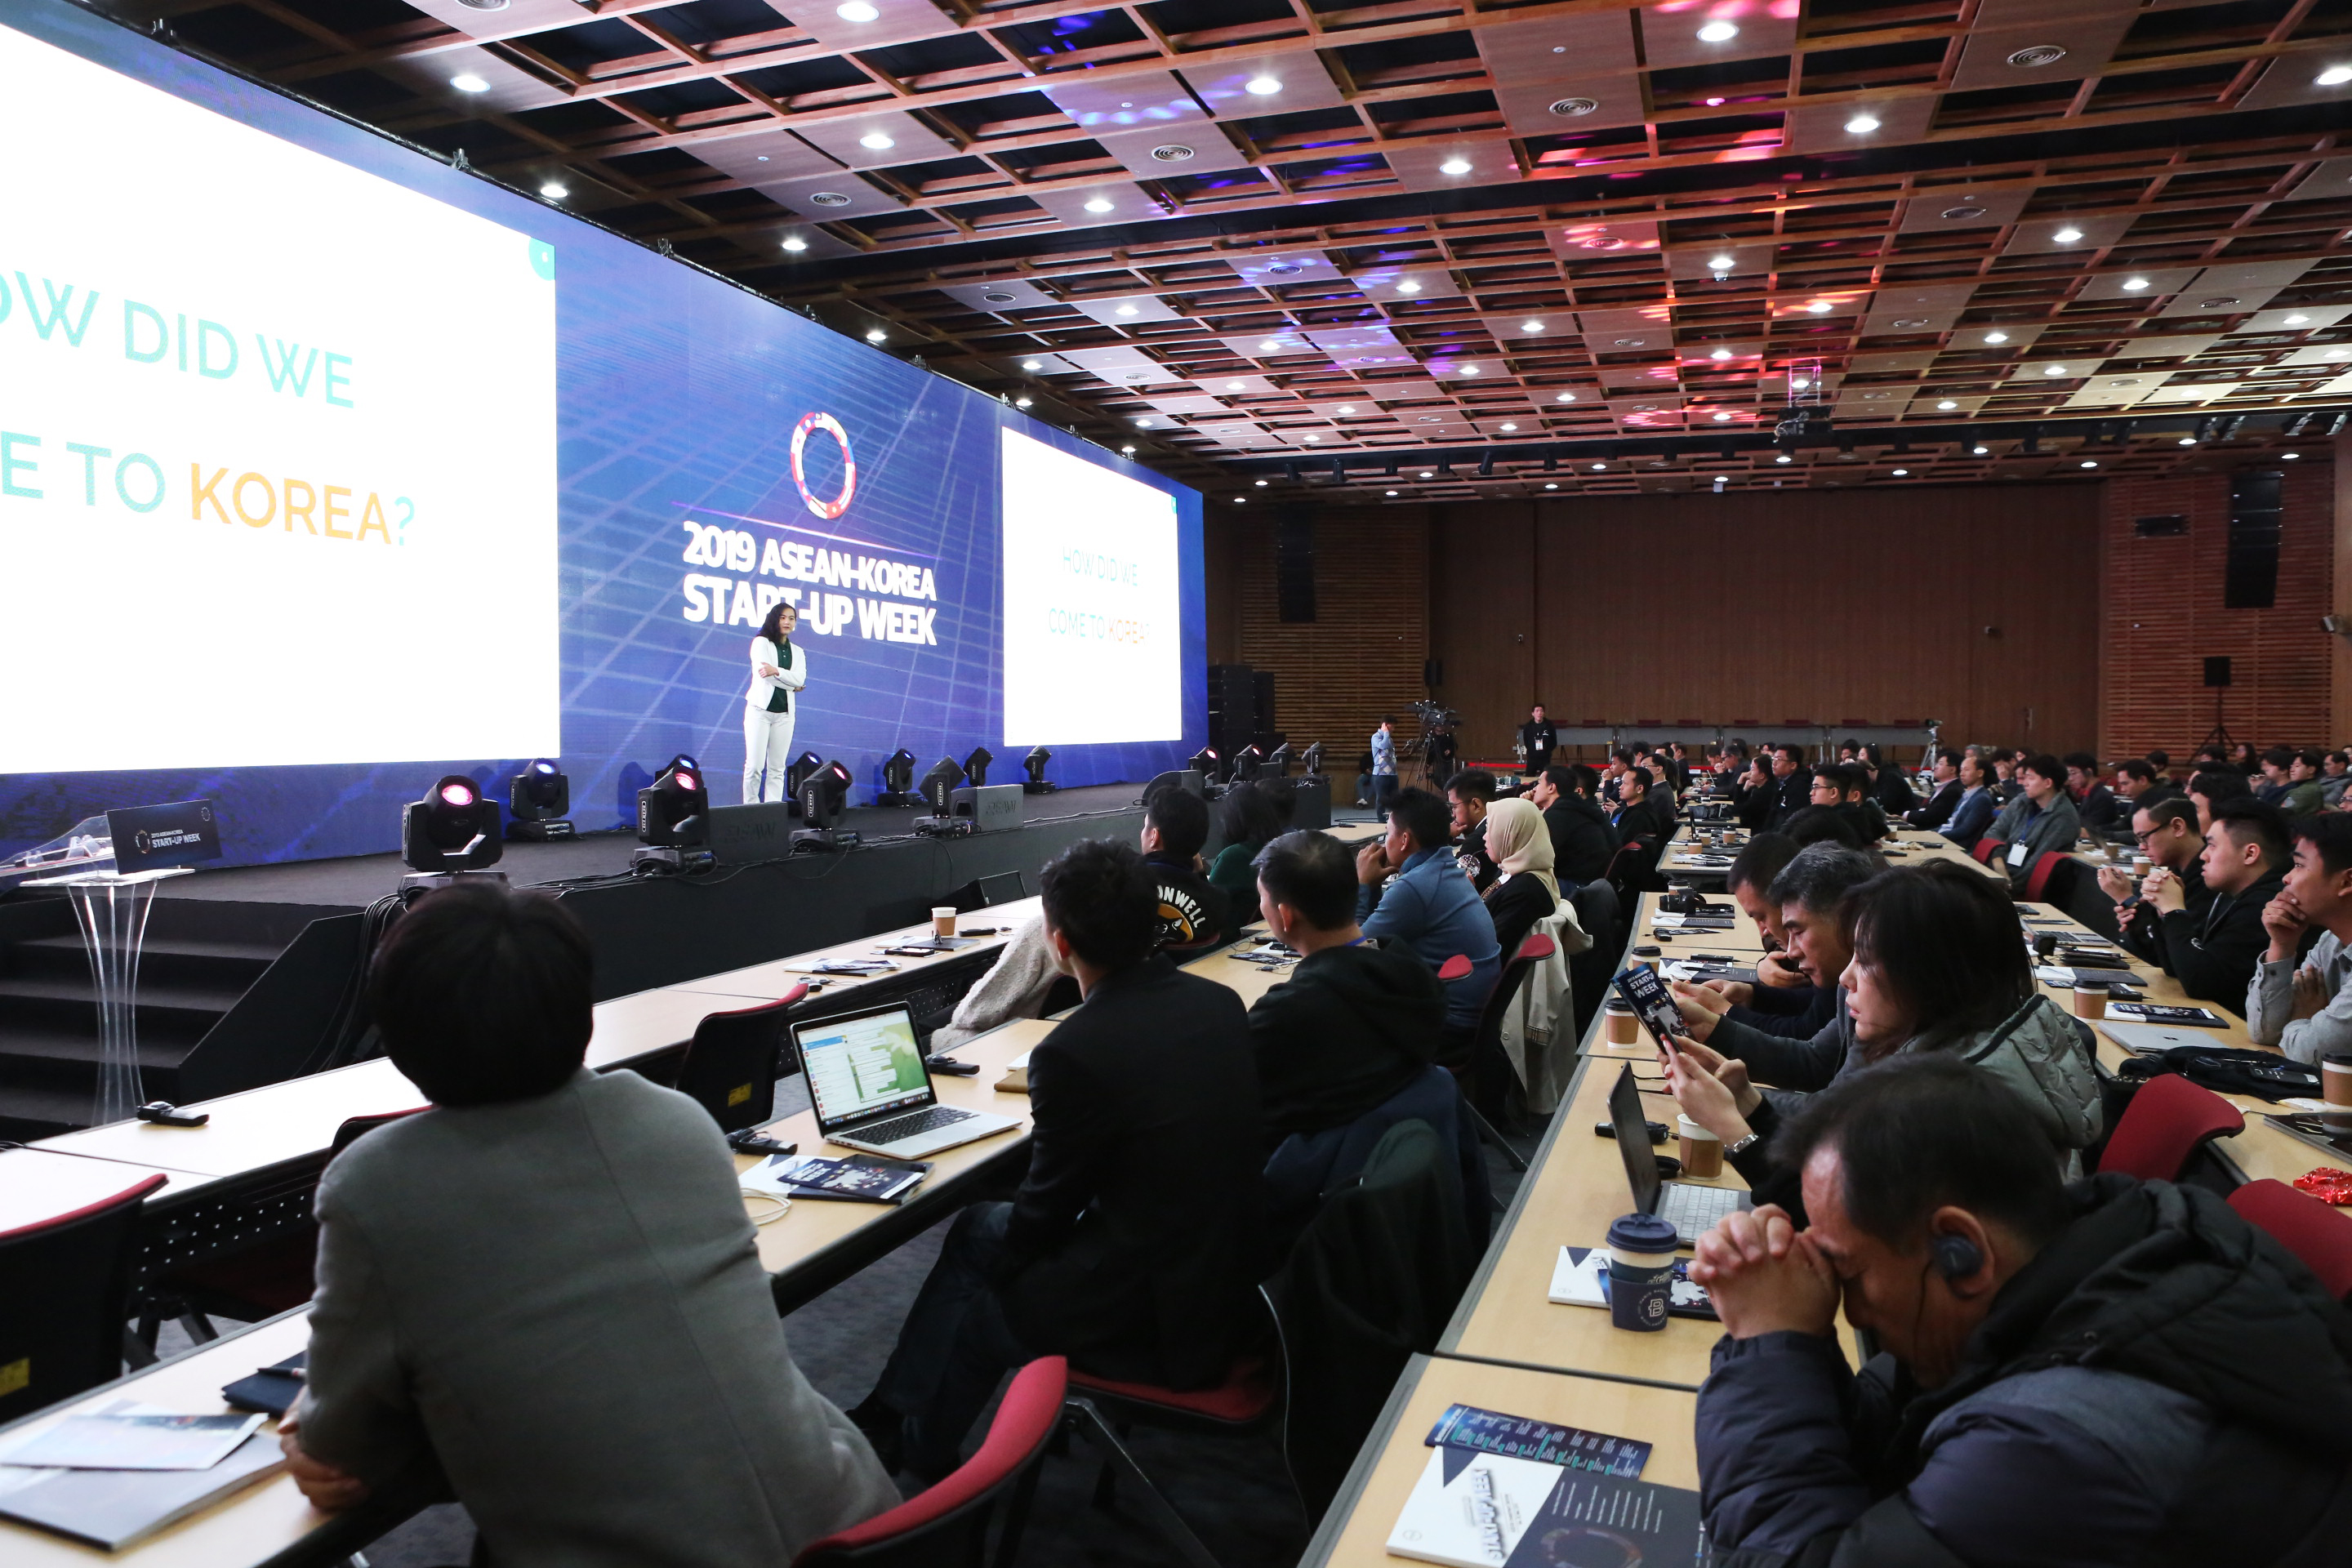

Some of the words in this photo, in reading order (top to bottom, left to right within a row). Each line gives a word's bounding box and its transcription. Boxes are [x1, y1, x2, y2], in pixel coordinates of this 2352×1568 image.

[0, 270, 100, 348] W
[124, 299, 239, 380] DID
[256, 333, 354, 408] WE
[66, 441, 166, 513] TO
[190, 462, 415, 546] KOREA?
[683, 520, 756, 572] 2019
[760, 538, 937, 601] ASEAN-KOREA
[1062, 546, 1094, 577] HOW
[1098, 555, 1117, 581] DID
[1120, 559, 1138, 587] WE
[858, 598, 938, 645] WEEK
[1049, 608, 1085, 637] COME
[1089, 614, 1105, 639] TO
[1108, 617, 1150, 645] KOREA?
[152, 835, 183, 849] START-UP
[182, 833, 201, 844] WEEK
[1634, 982, 1659, 999] WEEK
